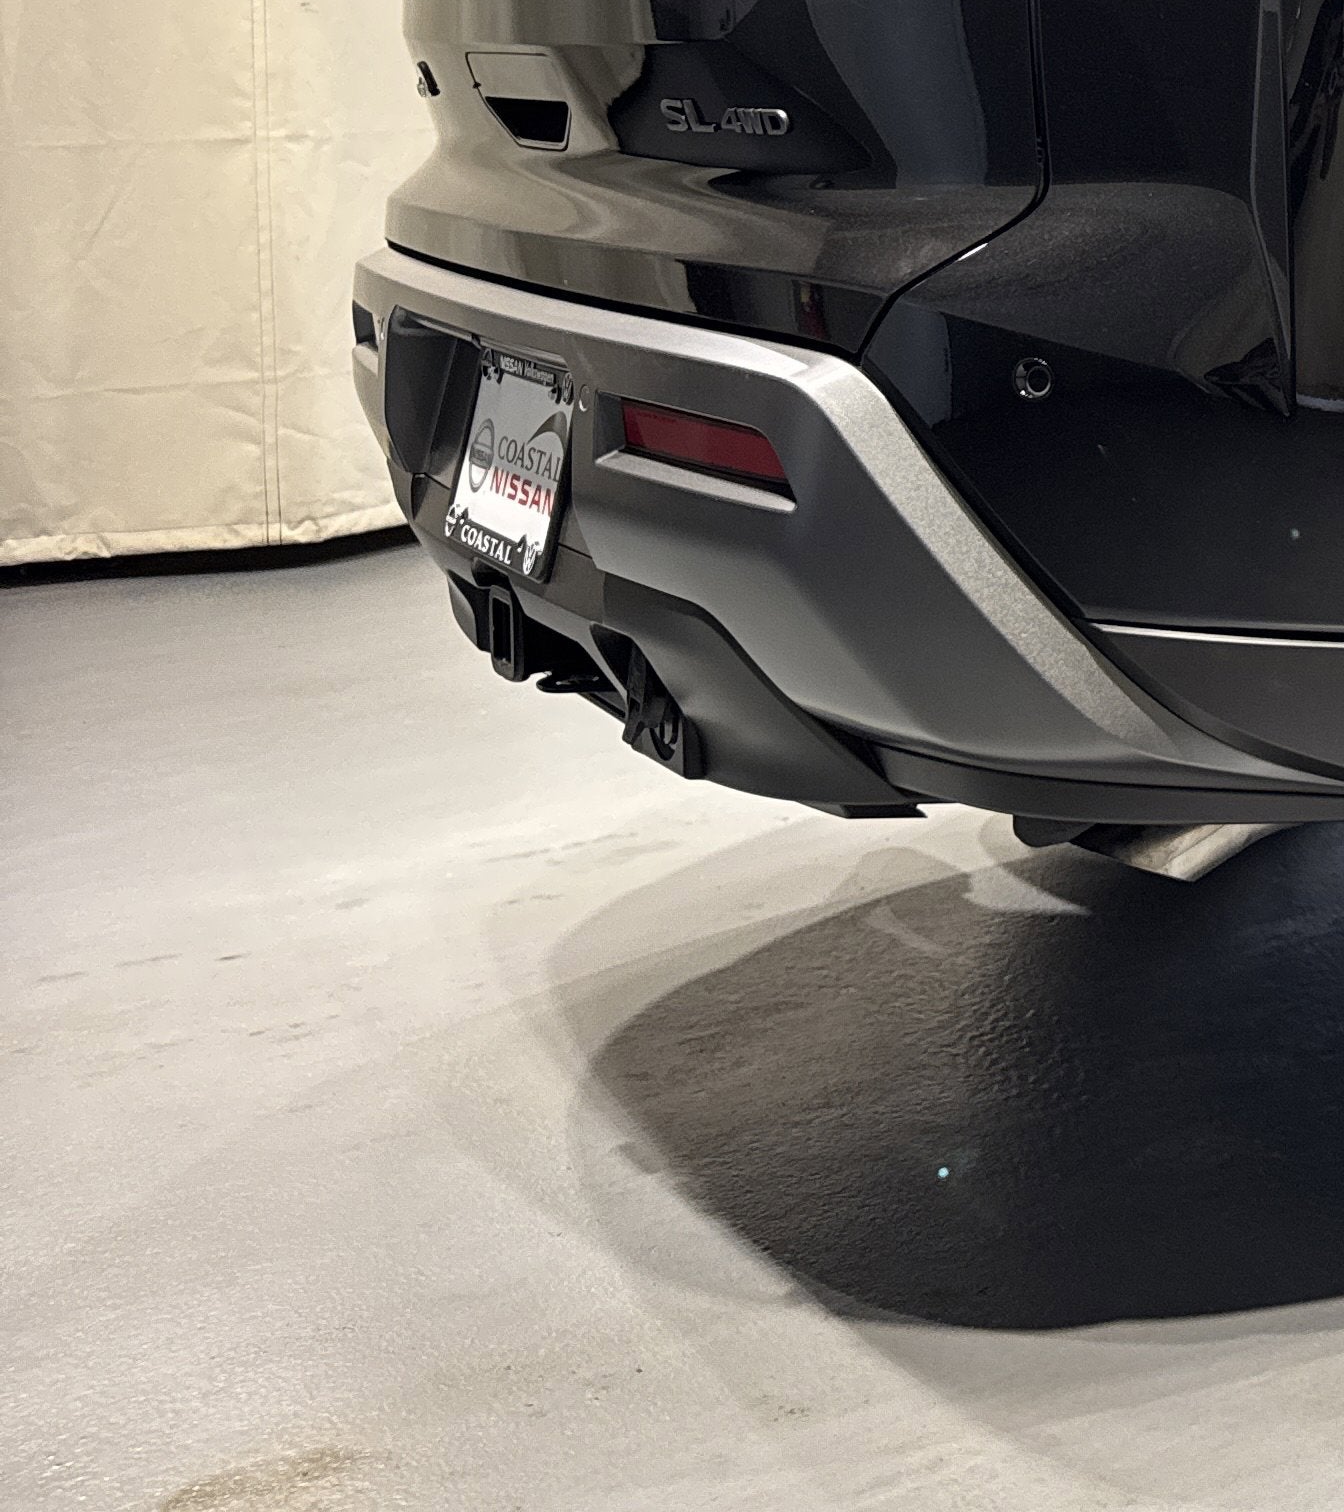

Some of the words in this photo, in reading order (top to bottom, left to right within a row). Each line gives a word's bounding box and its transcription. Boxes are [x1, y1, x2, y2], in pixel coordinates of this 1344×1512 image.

[659, 98, 717, 134] SL
[720, 106, 790, 136] 4WD
[499, 355, 523, 376] NISSAN
[498, 436, 562, 483] COASTAL
[490, 469, 555, 517] NISSAN
[461, 523, 512, 565] COASTAL
